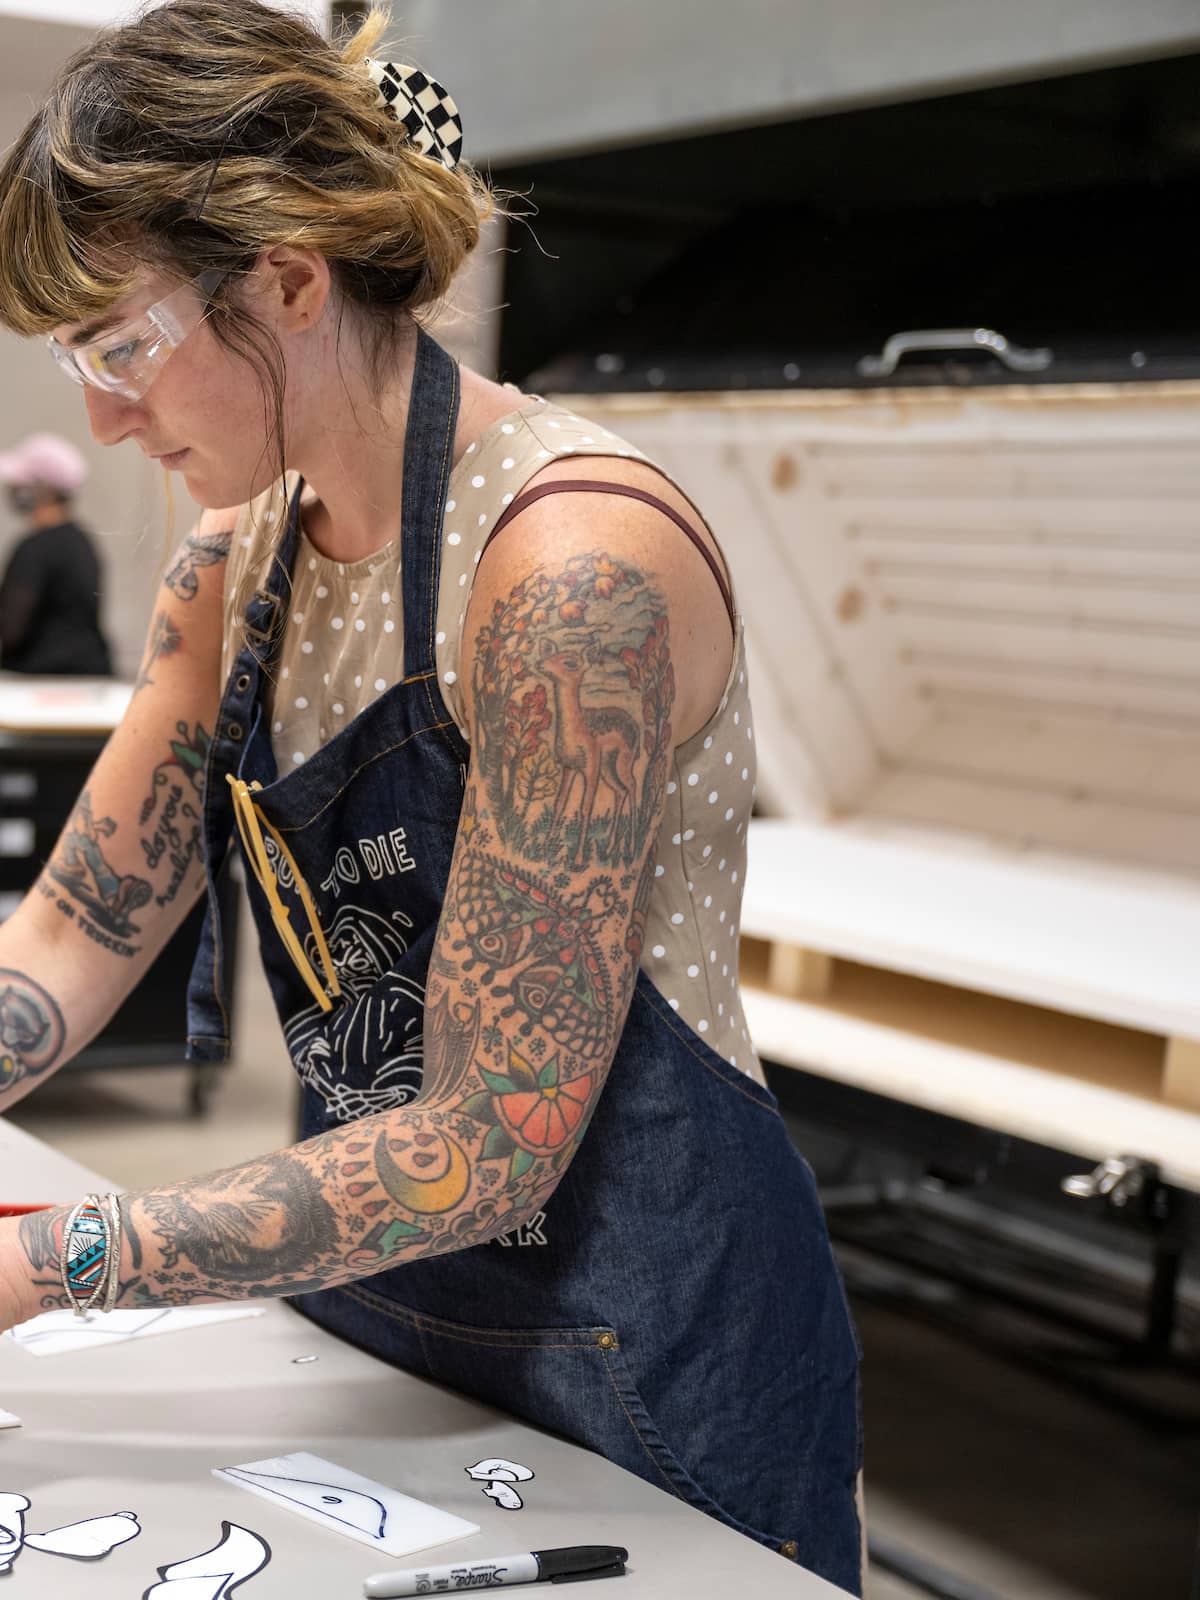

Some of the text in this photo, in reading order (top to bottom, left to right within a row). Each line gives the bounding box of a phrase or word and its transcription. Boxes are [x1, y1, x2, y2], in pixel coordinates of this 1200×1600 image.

[319, 846, 361, 898] TO
[358, 826, 417, 881] DIE
[56, 898, 76, 919] ON
